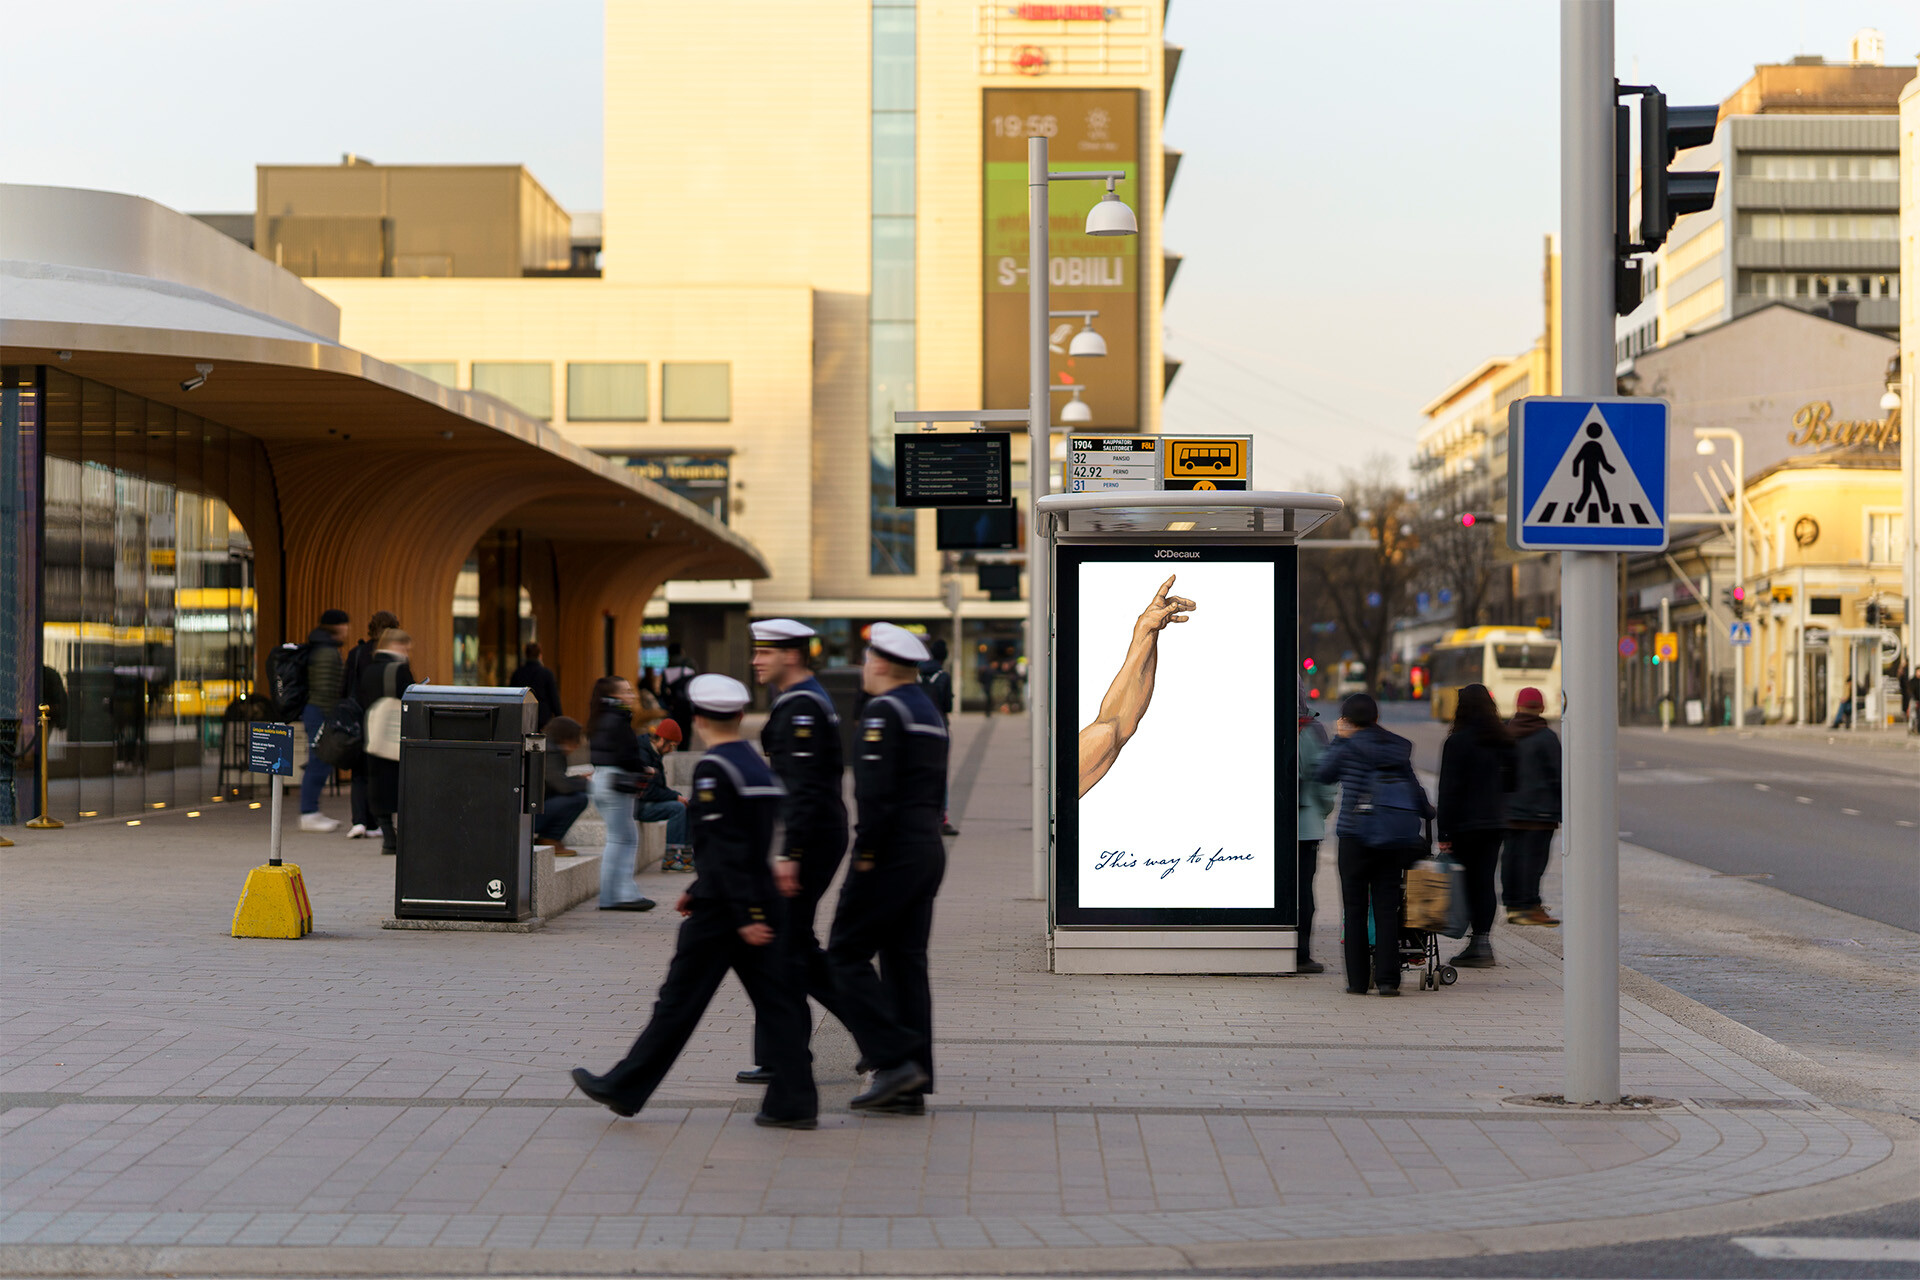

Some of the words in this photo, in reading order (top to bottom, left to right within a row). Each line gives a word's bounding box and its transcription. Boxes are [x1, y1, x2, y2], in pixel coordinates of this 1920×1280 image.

[998, 256, 1123, 286] S-OBIILI
[1074, 440, 1093, 449] 1904
[1073, 452, 1087, 464] 32
[1073, 466, 1102, 478] 42.92
[1073, 480, 1085, 491] 31
[1154, 549, 1201, 559] JCDecaux
[1095, 850, 1137, 870] This
[1143, 857, 1181, 880] way
[1186, 846, 1205, 863] to
[1205, 847, 1254, 871] fame
